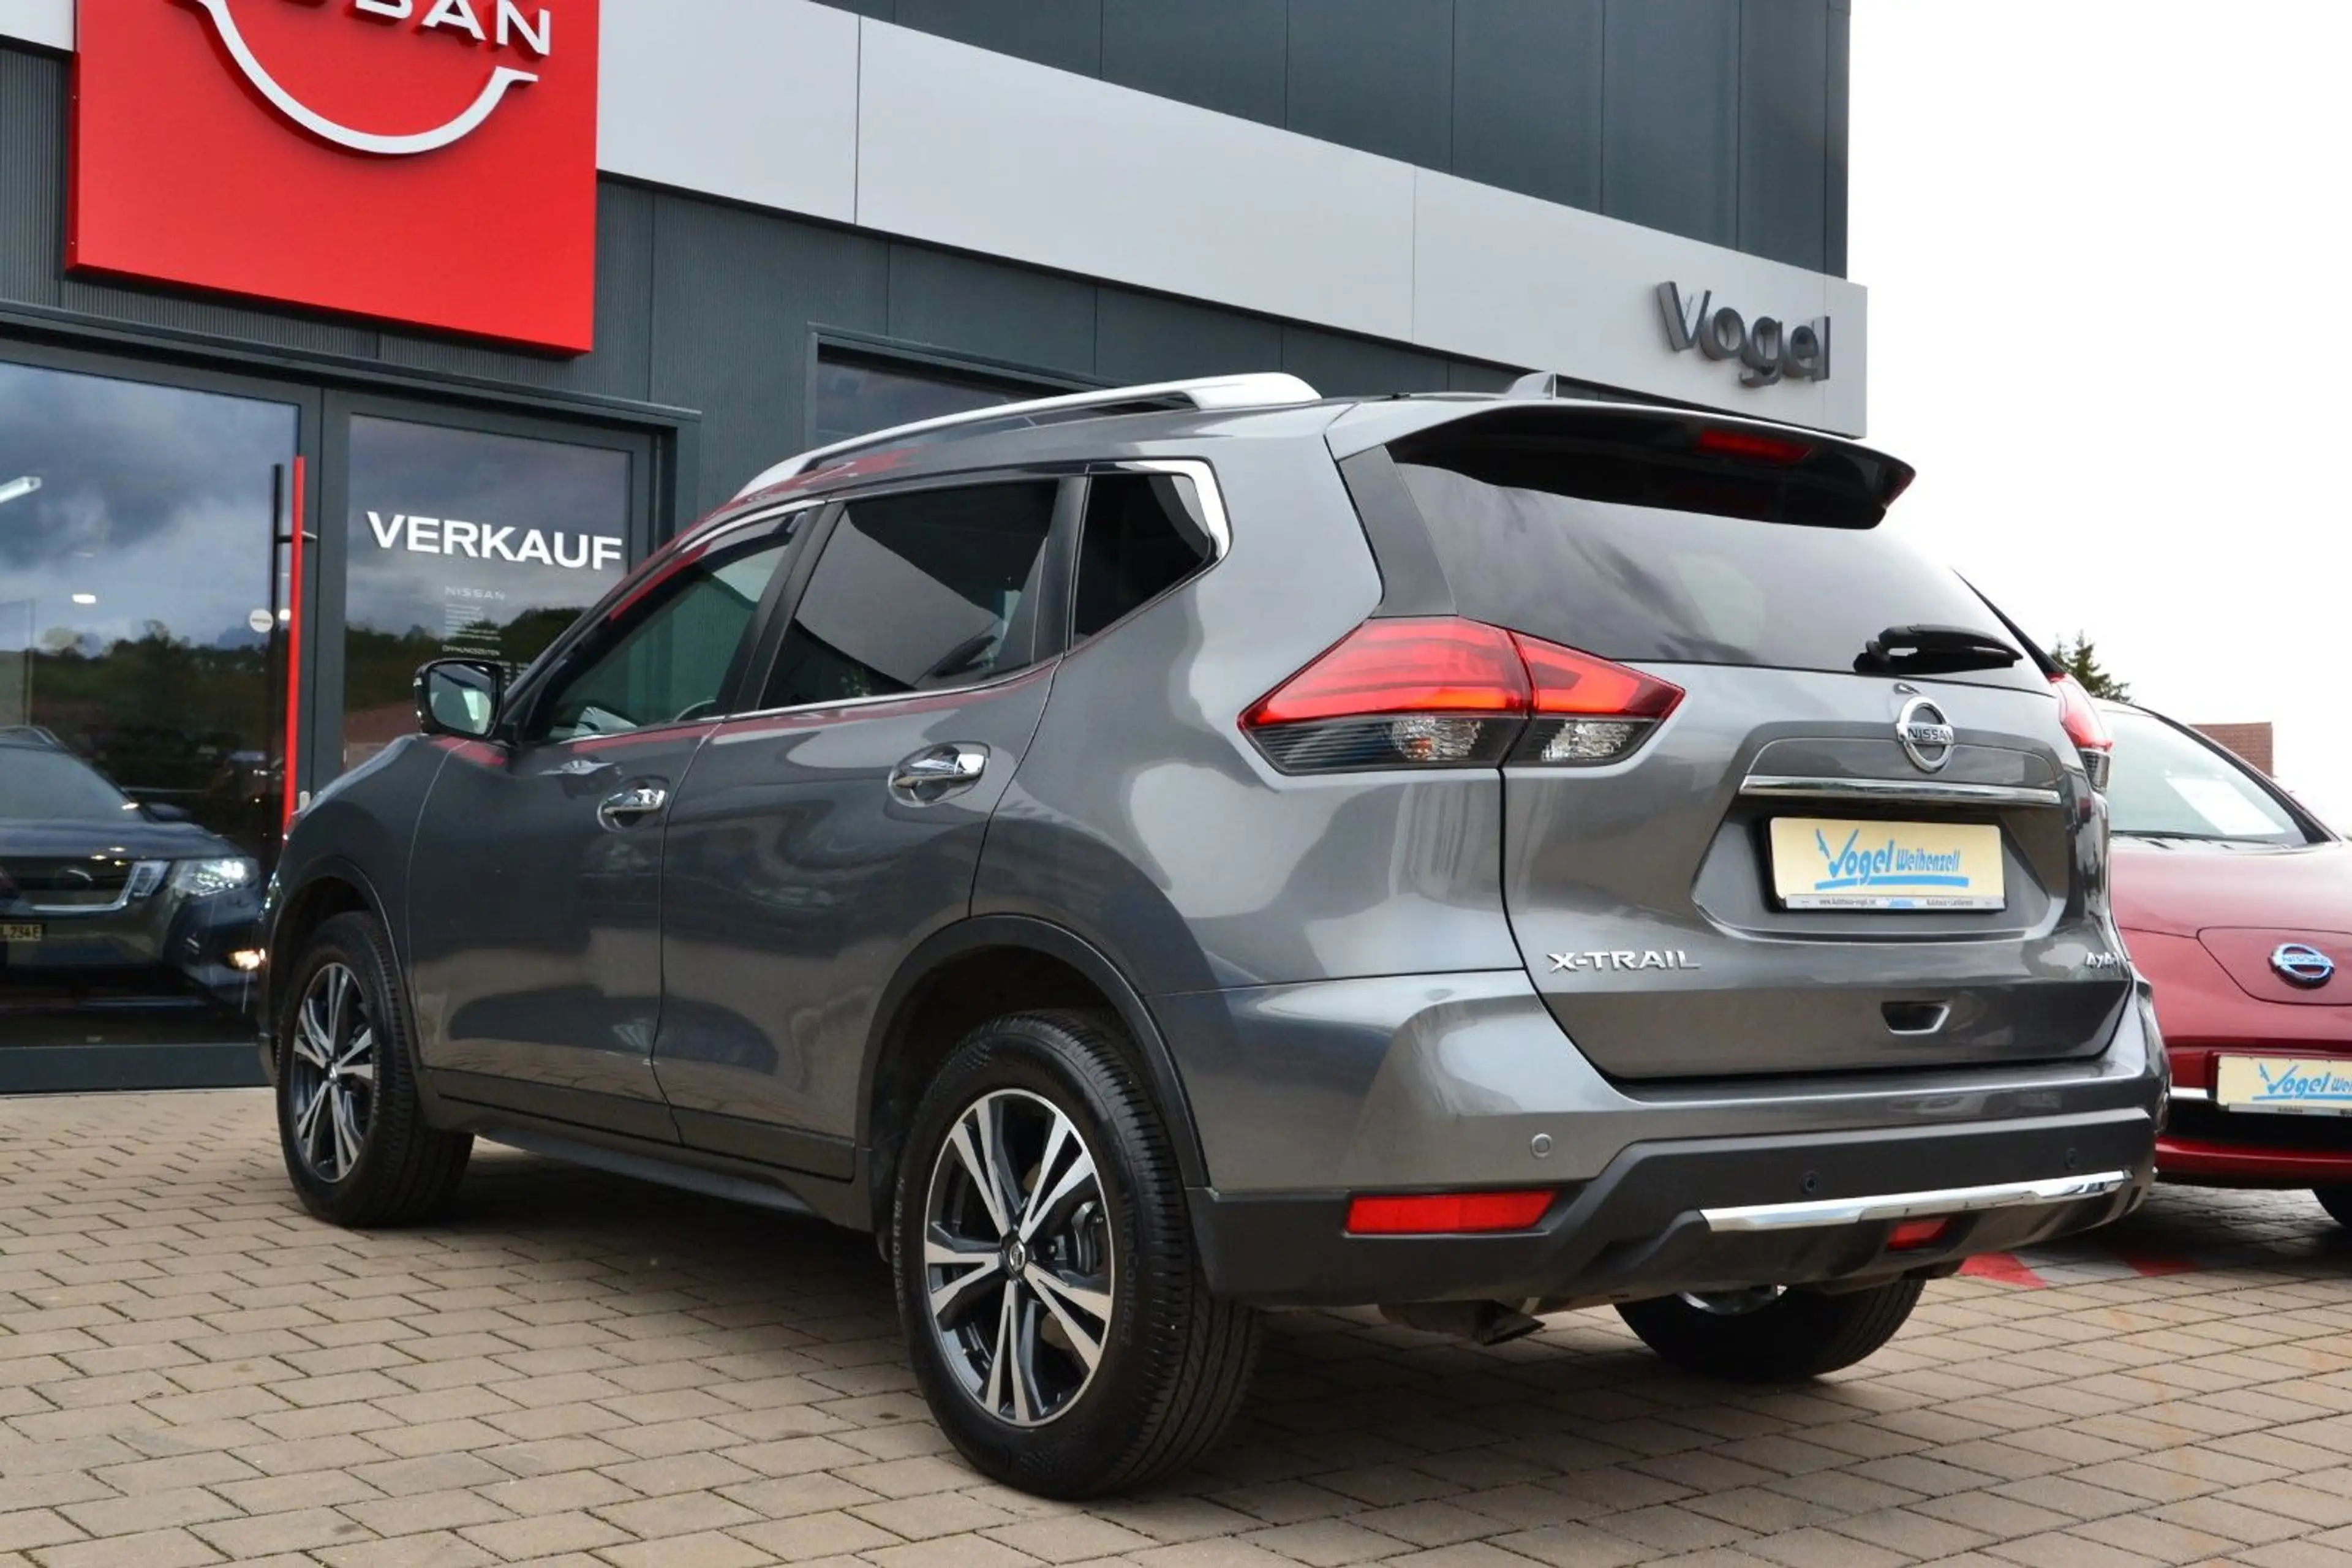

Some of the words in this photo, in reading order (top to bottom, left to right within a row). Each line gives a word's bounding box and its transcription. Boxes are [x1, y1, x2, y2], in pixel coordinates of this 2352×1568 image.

[355, 0, 550, 56] AN
[1657, 280, 1831, 388] Vogel
[367, 511, 623, 570] VERKAUF
[445, 585, 507, 600] NISSAN
[1907, 728, 1952, 741] NISSAN
[1815, 827, 1895, 884] Vogel
[1896, 847, 1961, 872] Weihenzell
[1547, 951, 1703, 973] X-TRAIL
[2258, 1062, 2331, 1096] Vogel
